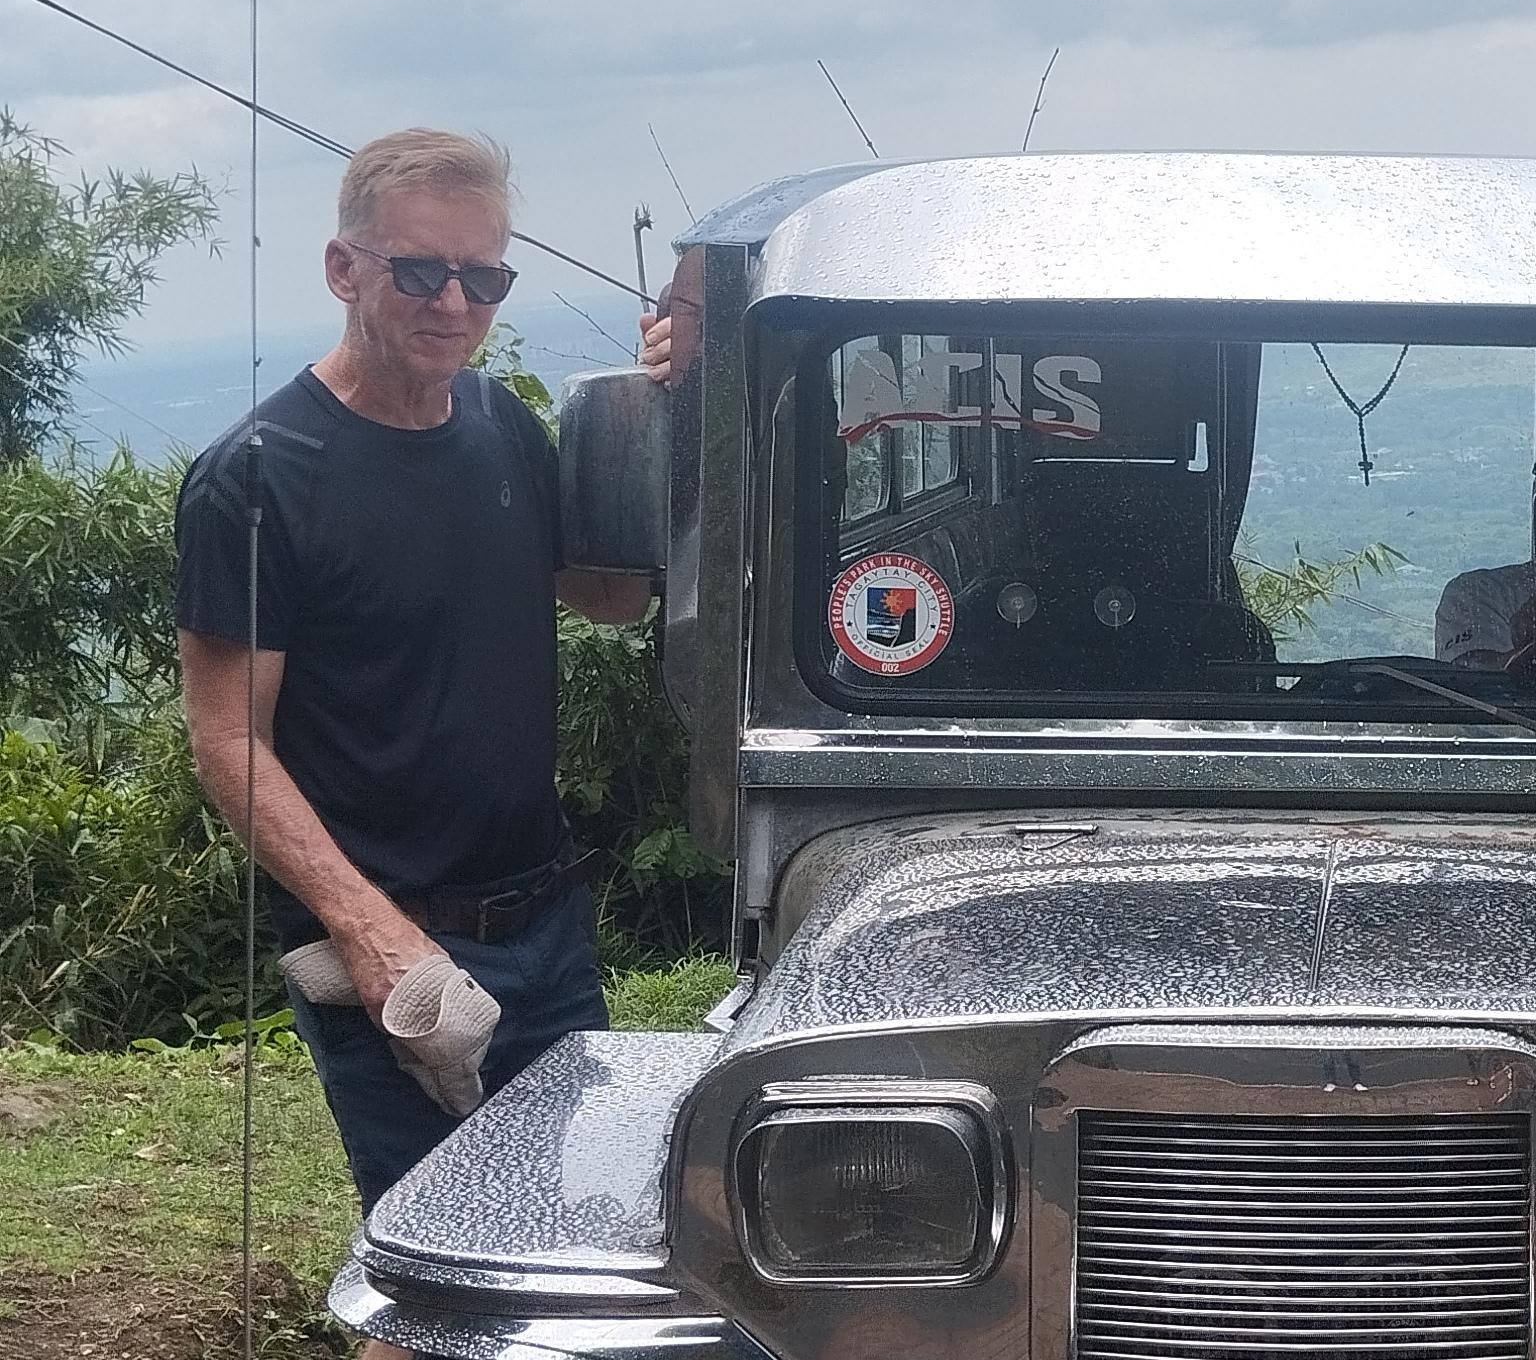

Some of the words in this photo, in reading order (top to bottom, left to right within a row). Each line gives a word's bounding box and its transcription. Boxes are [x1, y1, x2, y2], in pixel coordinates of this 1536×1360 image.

[832, 579, 852, 629] PEOPLE'S
[851, 559, 876, 578] PARK
[880, 556, 892, 565] IN
[897, 557, 918, 571] THE
[920, 567, 939, 584] SKY
[934, 587, 952, 636] SHUTTLE
[845, 568, 911, 608] TAGAYTAY
[917, 581, 938, 612] CITY
[852, 634, 899, 660] OFFICIAL
[905, 639, 929, 657] SEAL
[881, 662, 900, 672] 002
